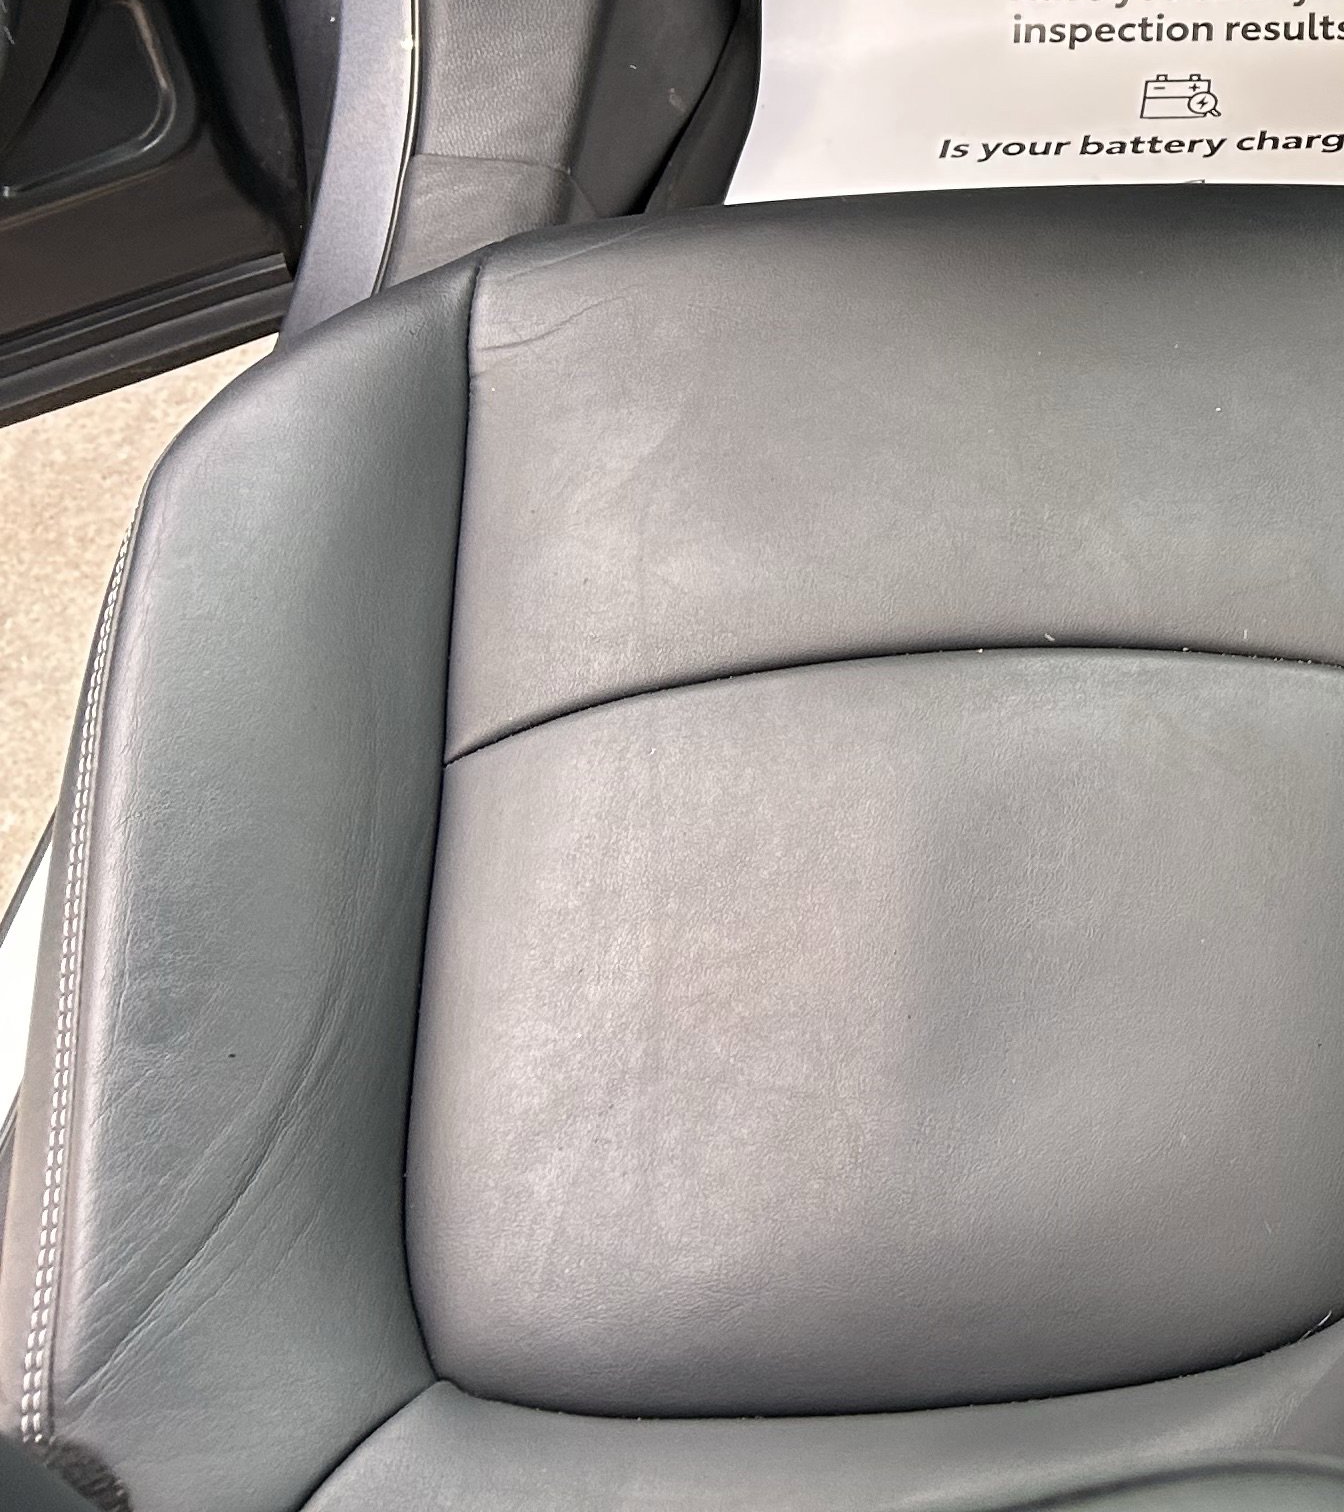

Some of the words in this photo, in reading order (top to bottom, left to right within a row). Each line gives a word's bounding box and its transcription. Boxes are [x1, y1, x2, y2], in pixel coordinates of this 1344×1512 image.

[1014, 14, 1213, 50] inspection
[939, 140, 969, 158] Is
[977, 141, 1071, 162] your
[1080, 135, 1227, 158] battery
